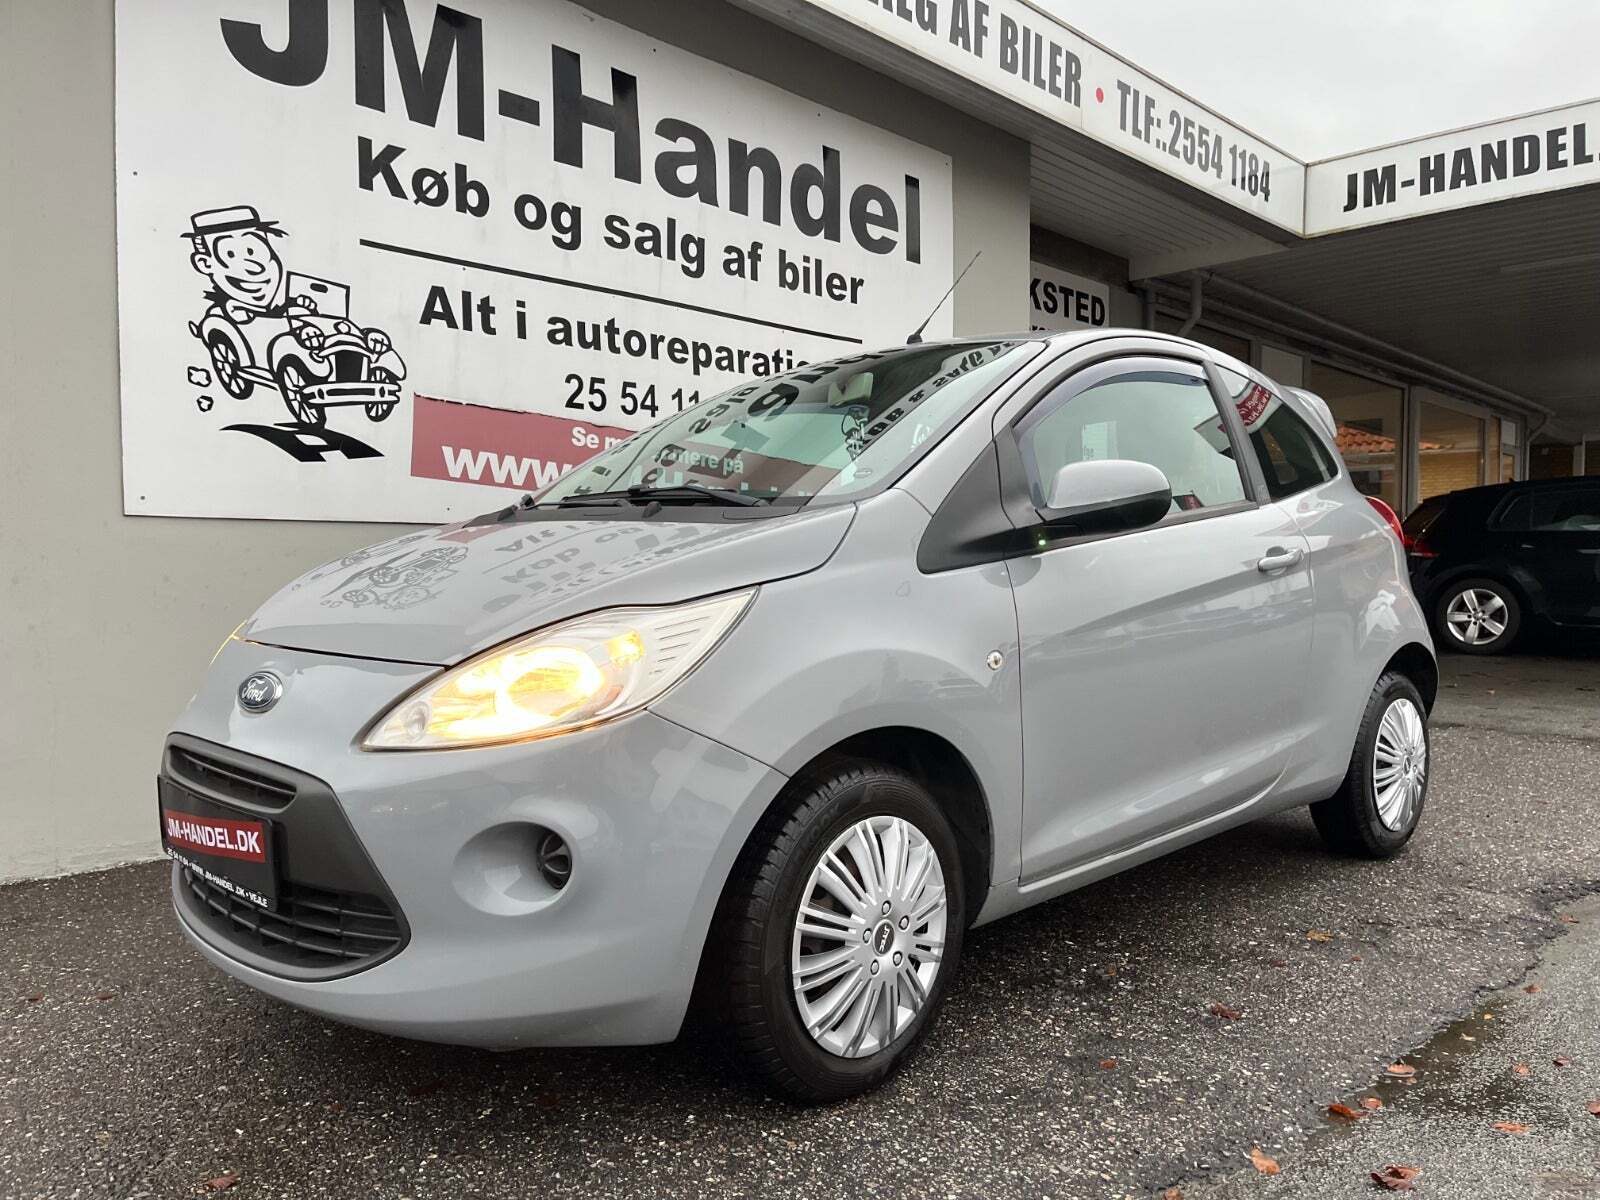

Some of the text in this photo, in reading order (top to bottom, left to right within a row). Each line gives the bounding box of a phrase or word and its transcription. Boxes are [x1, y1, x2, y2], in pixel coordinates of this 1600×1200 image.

[220, 0, 921, 264] JM-Handel
[949, 0, 989, 59] AF
[1000, 13, 1082, 108] BILER
[1229, 144, 1270, 203] 1184
[357, 135, 865, 305] Køb og salg af biler
[419, 285, 809, 377] Alt i autoreparati
[564, 373, 607, 412] 25
[620, 381, 660, 418] 54
[571, 426, 600, 449] Se
[241, 677, 268, 702] Ford
[167, 817, 262, 854] JM-HANDEL.DK
